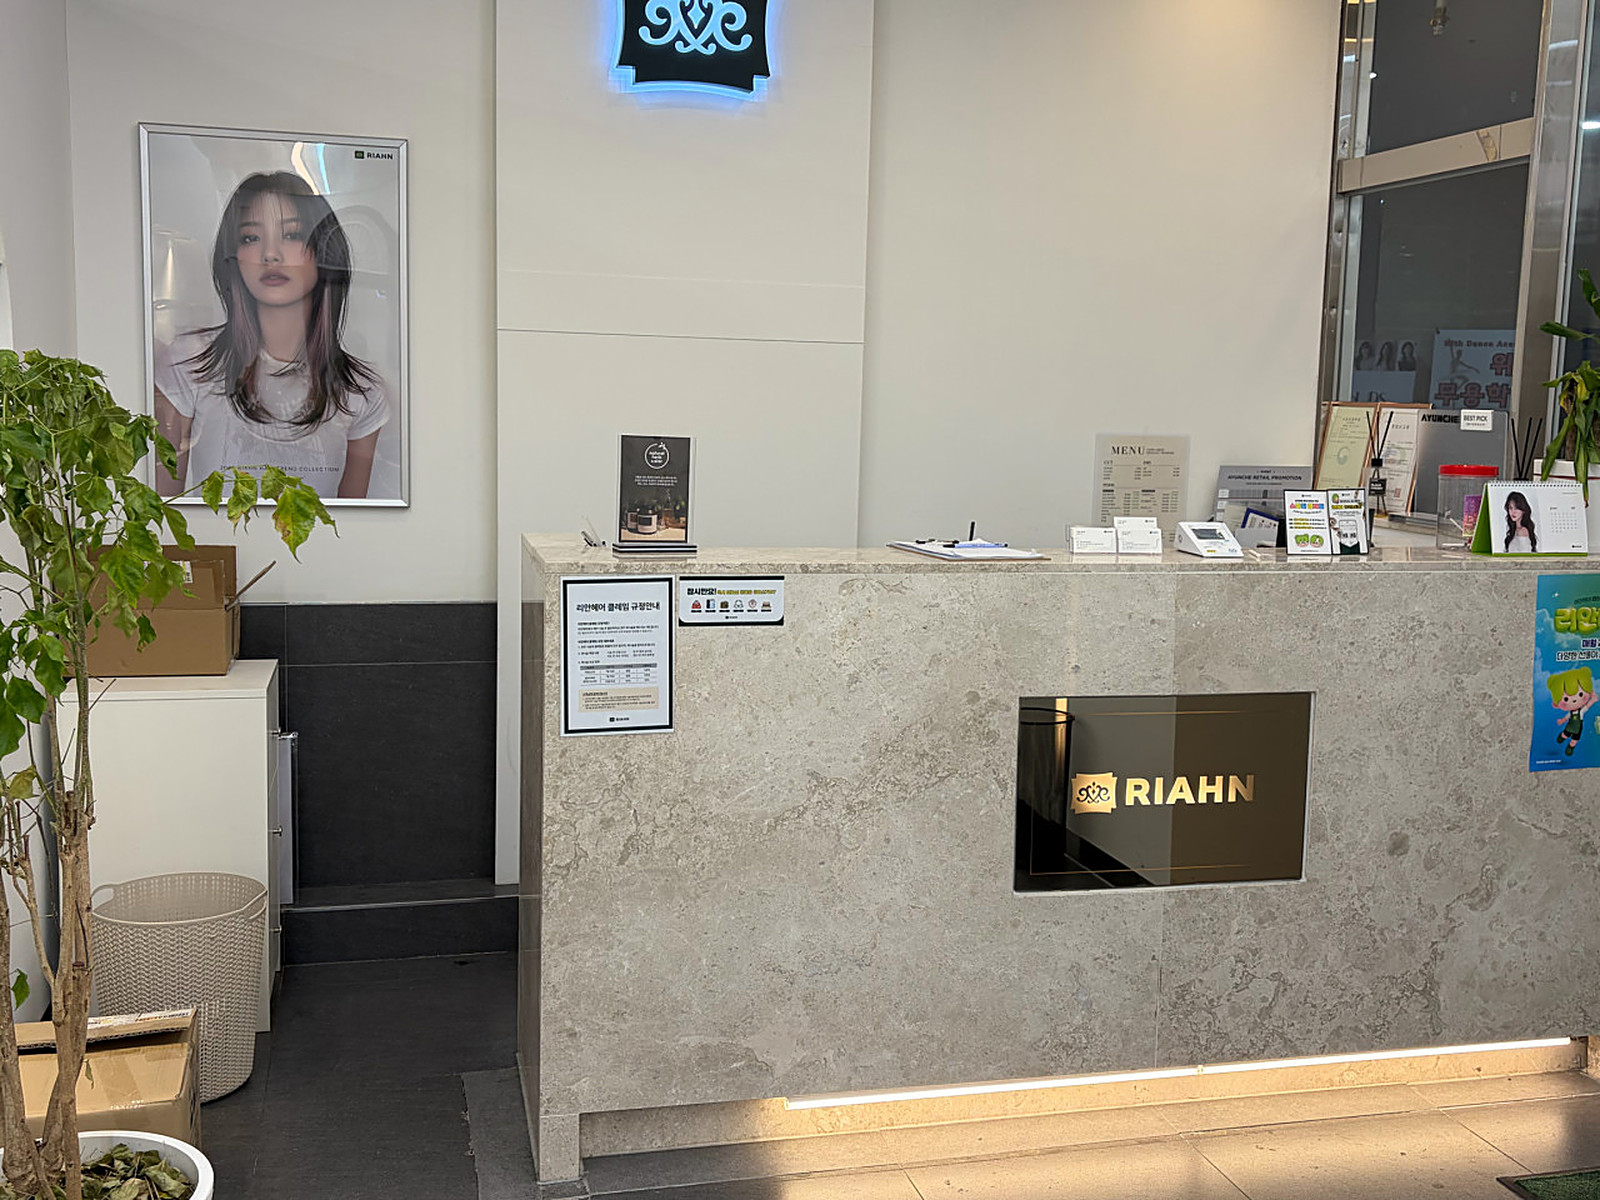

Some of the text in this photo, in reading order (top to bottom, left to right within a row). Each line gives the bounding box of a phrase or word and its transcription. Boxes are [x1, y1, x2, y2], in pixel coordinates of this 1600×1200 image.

[366, 152, 394, 160] RIAHN
[1463, 414, 1488, 422] BEST PICK
[1111, 445, 1145, 455] MENU
[576, 601, 660, 612] 리안헤어 클레임 규정안내
[1125, 774, 1255, 806] RIAHN
